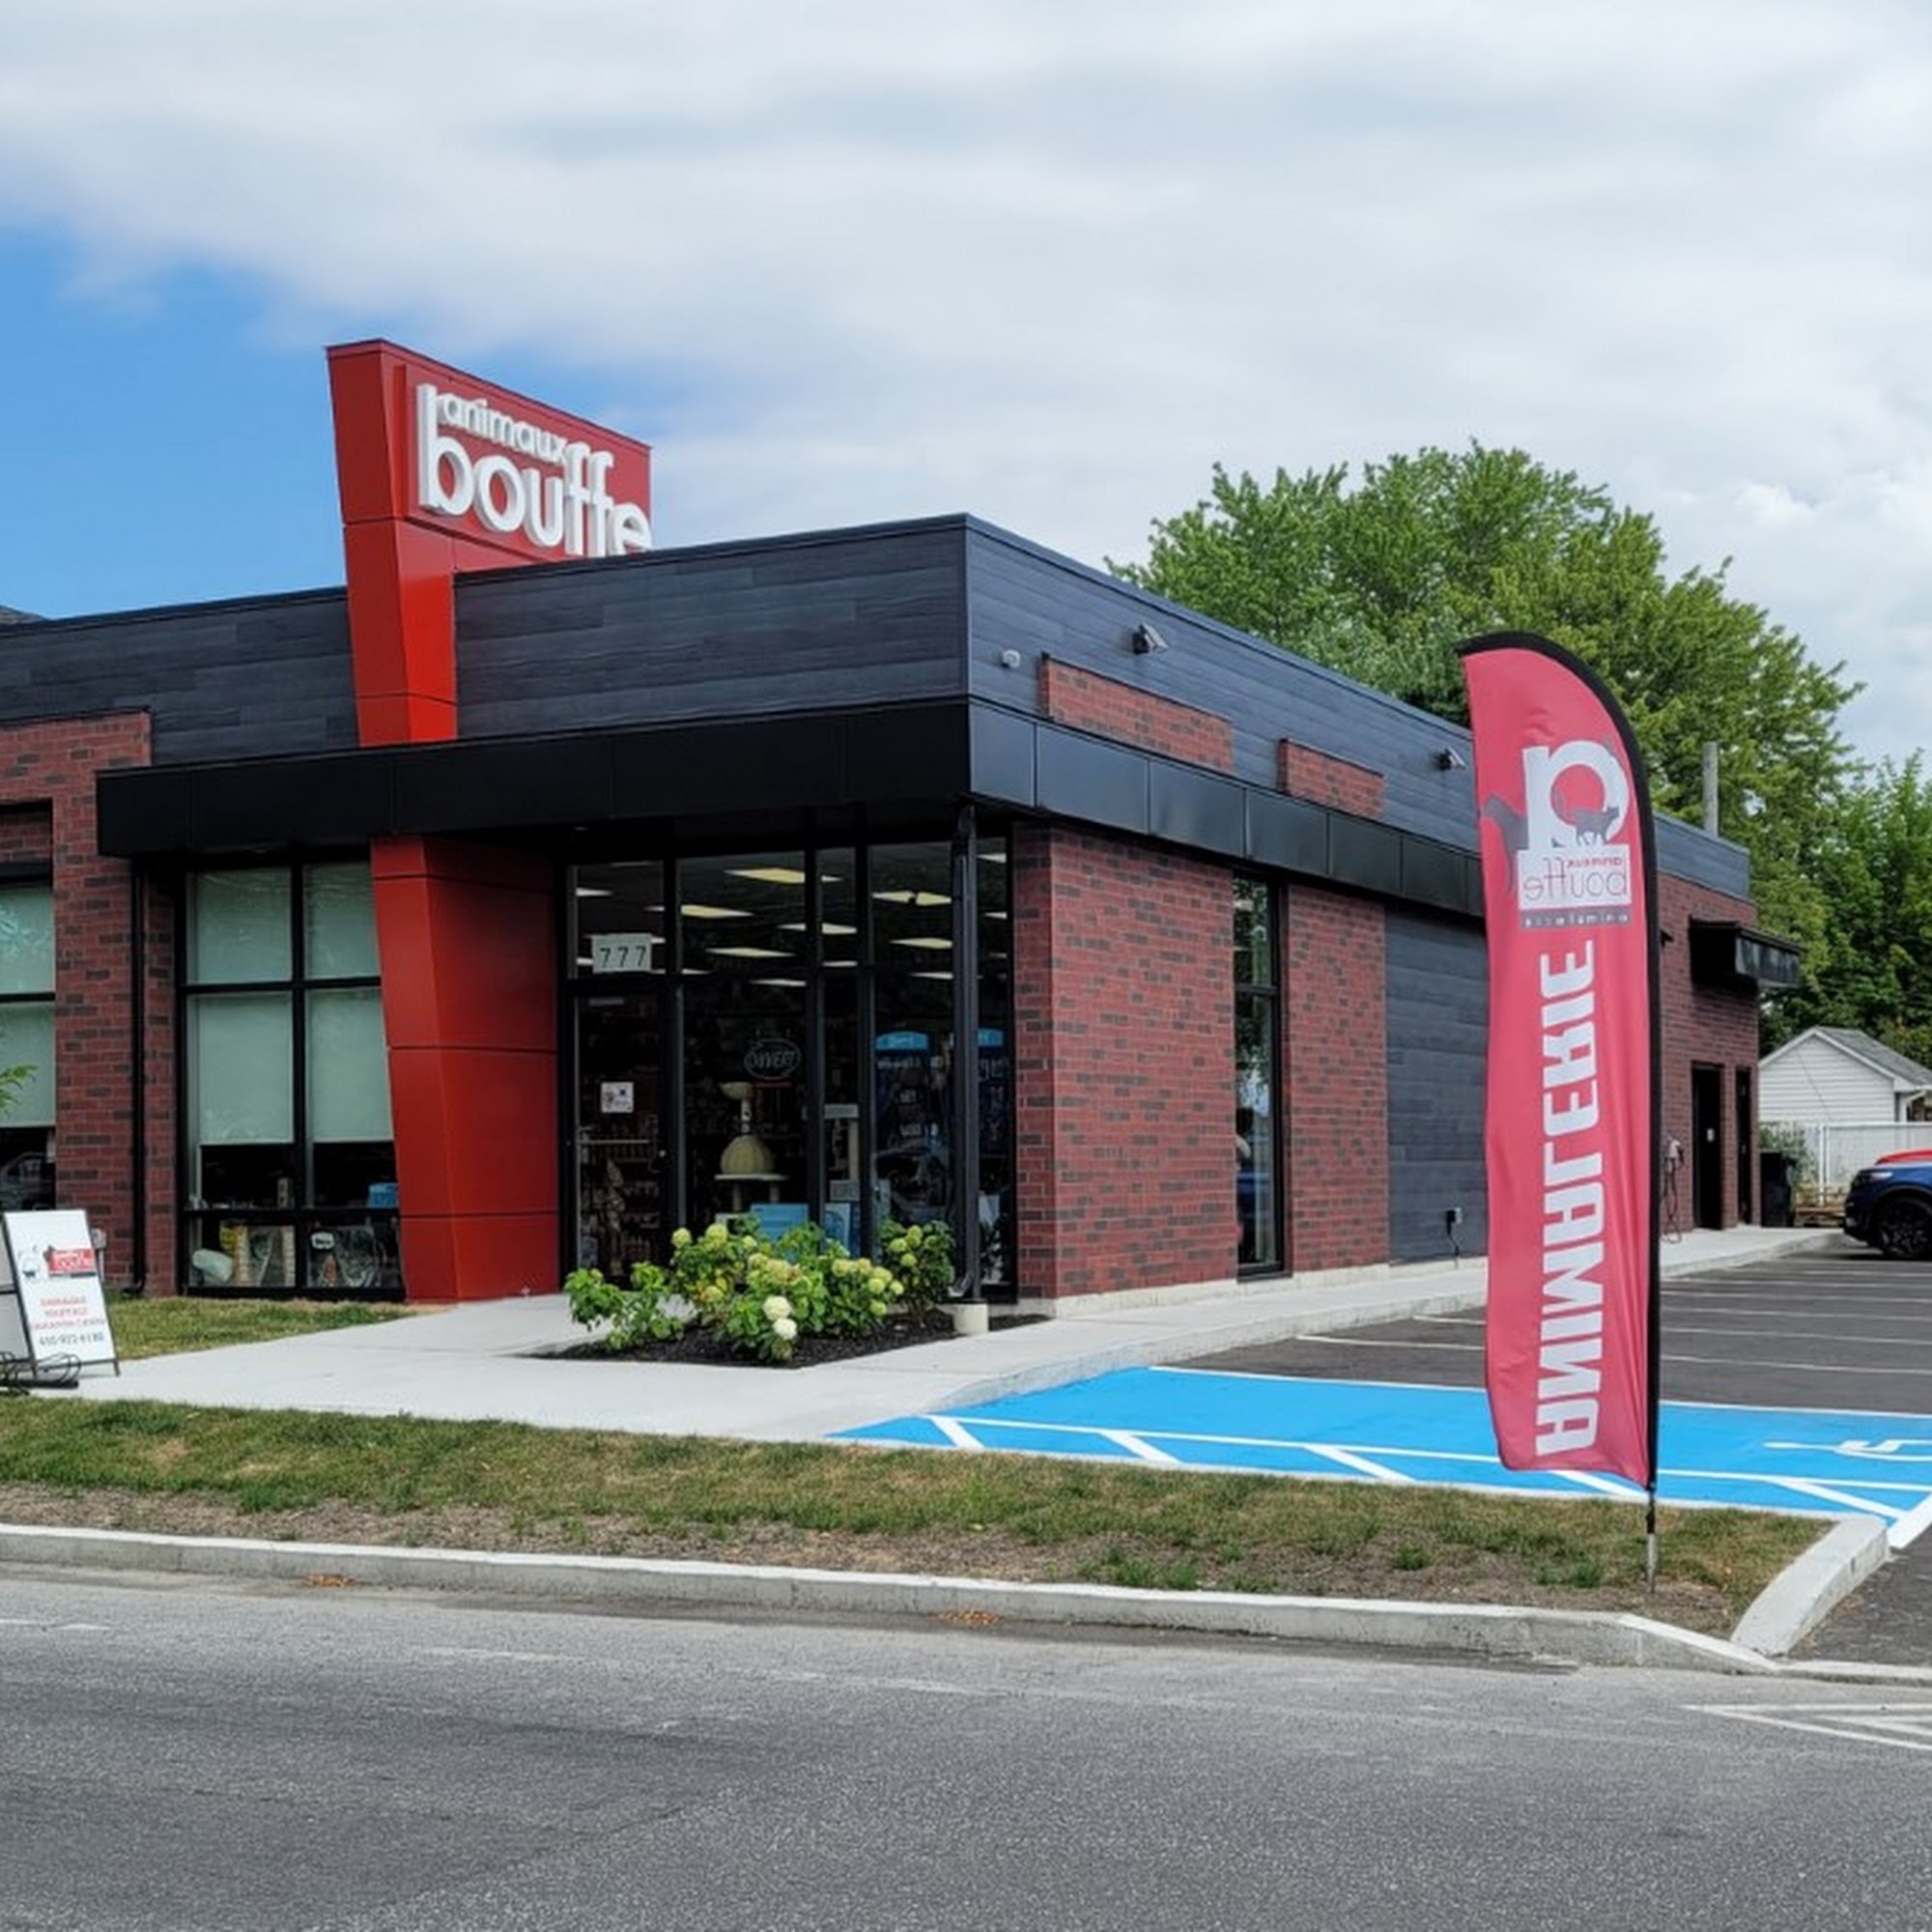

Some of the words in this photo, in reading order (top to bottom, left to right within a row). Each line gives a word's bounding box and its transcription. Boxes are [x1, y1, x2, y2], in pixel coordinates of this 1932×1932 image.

[438, 393, 568, 463] animaux
[416, 384, 653, 557] bouffe
[599, 945, 647, 968] 777
